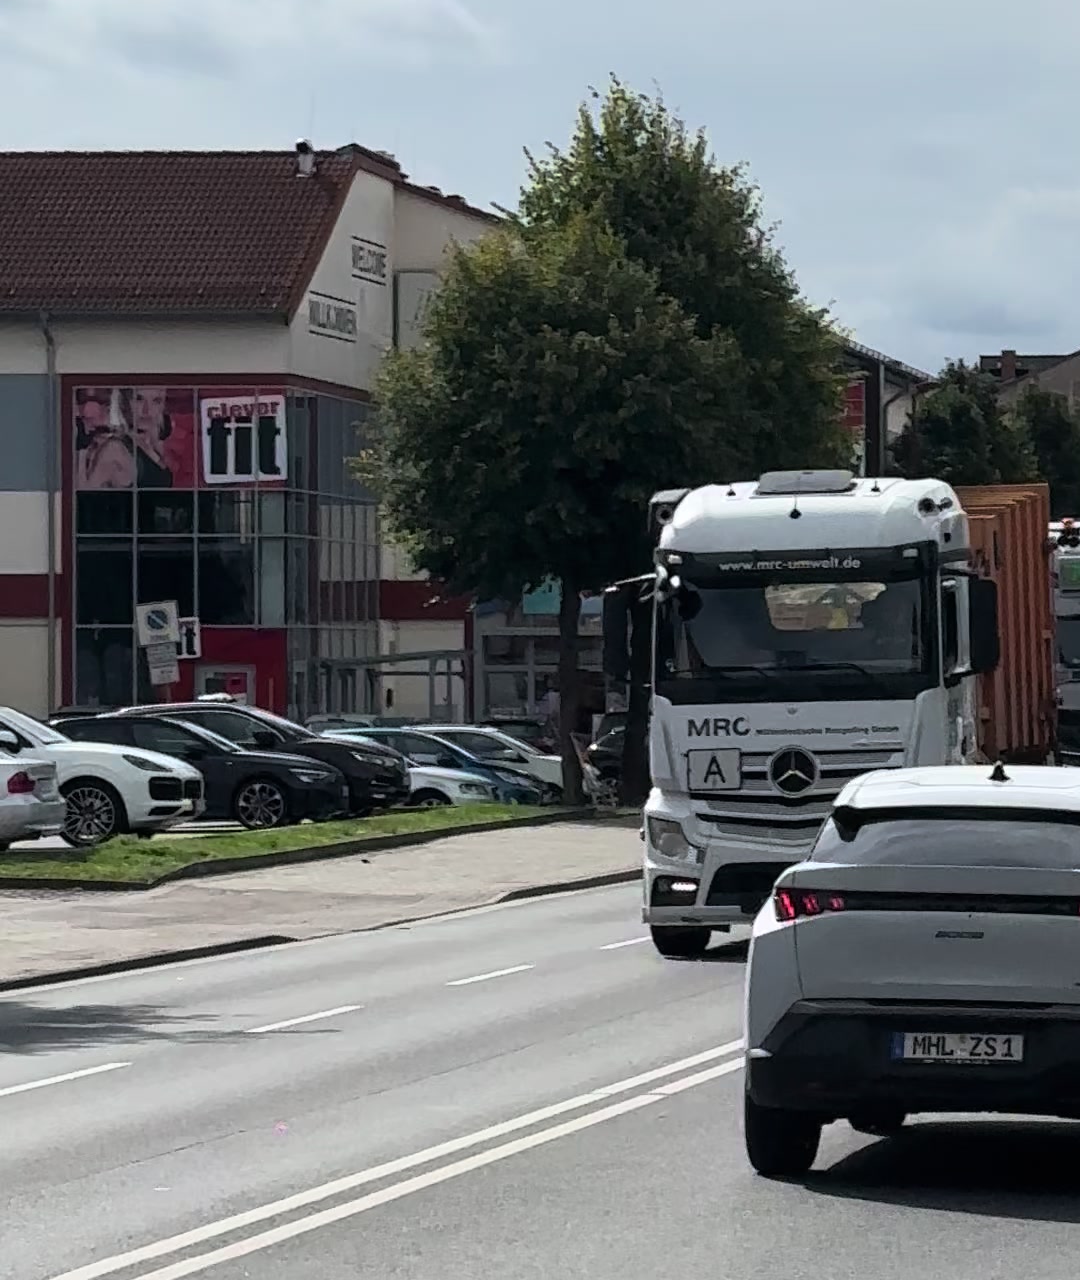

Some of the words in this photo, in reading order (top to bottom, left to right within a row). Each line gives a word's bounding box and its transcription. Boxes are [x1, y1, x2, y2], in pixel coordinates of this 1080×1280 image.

[206, 416, 281, 475] fit
[719, 557, 861, 570] www.mrc-umwelt.de
[688, 717, 751, 736] MRC
[703, 756, 726, 784] A
[912, 1036, 954, 1056] MHL
